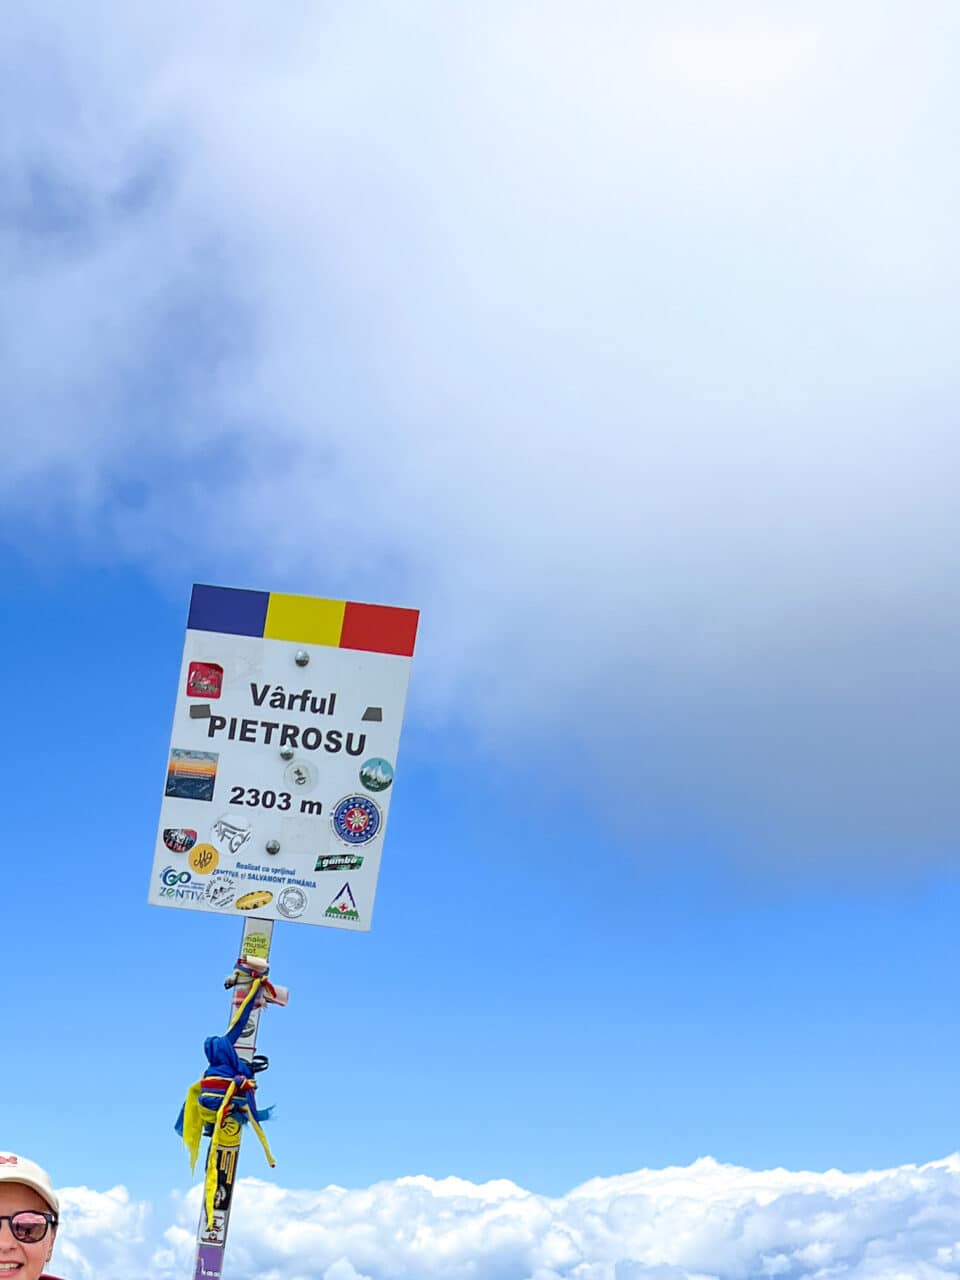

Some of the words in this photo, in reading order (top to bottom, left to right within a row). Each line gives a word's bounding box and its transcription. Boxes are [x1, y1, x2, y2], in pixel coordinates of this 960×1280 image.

[250, 682, 337, 716] Vârful
[208, 715, 366, 756] PIETROSU
[229, 786, 292, 811] 2303
[300, 798, 323, 815] m
[247, 872, 286, 885] SALVAMONT
